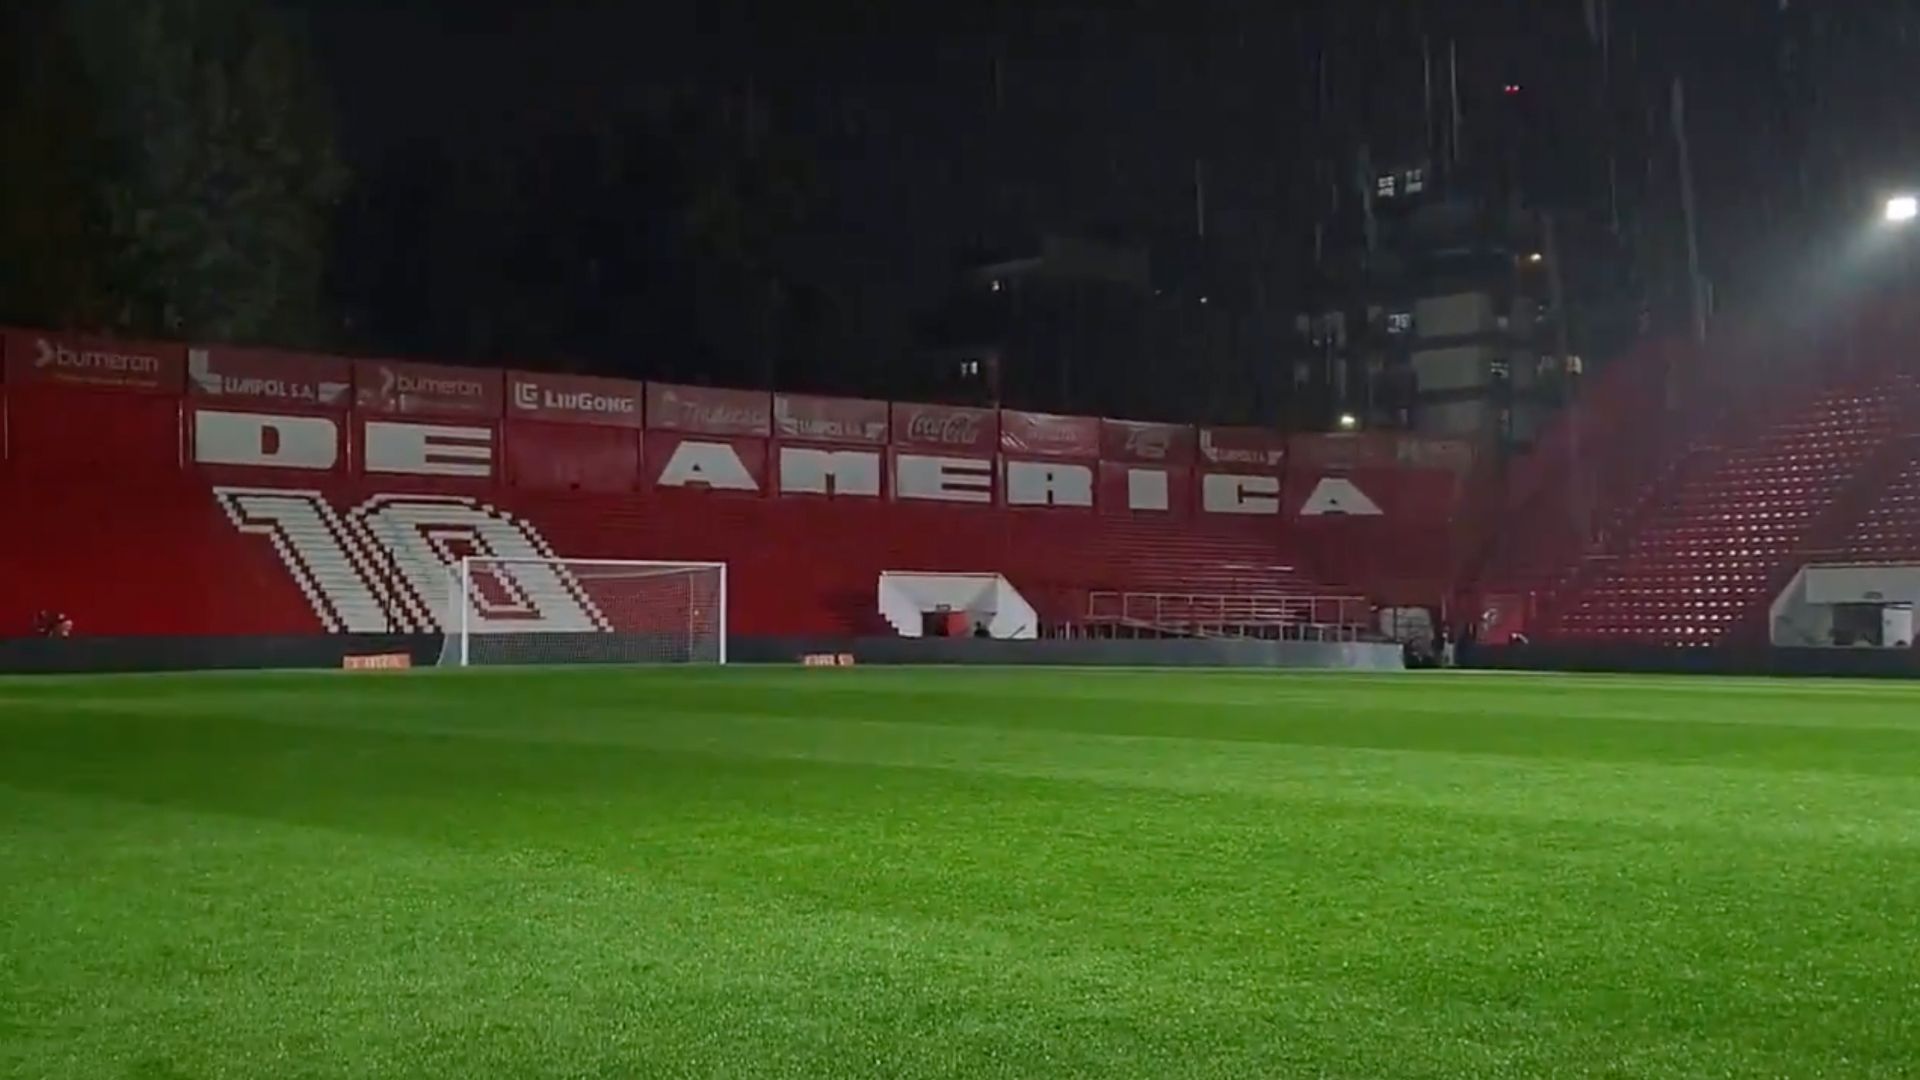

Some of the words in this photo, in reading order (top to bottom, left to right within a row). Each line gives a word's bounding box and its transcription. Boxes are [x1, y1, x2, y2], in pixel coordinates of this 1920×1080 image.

[56, 344, 159, 372] bumeran
[397, 375, 483, 396] bumeran
[194, 410, 492, 477] DE
[656, 440, 1384, 516] AMERICA
[213, 486, 614, 633] 10
